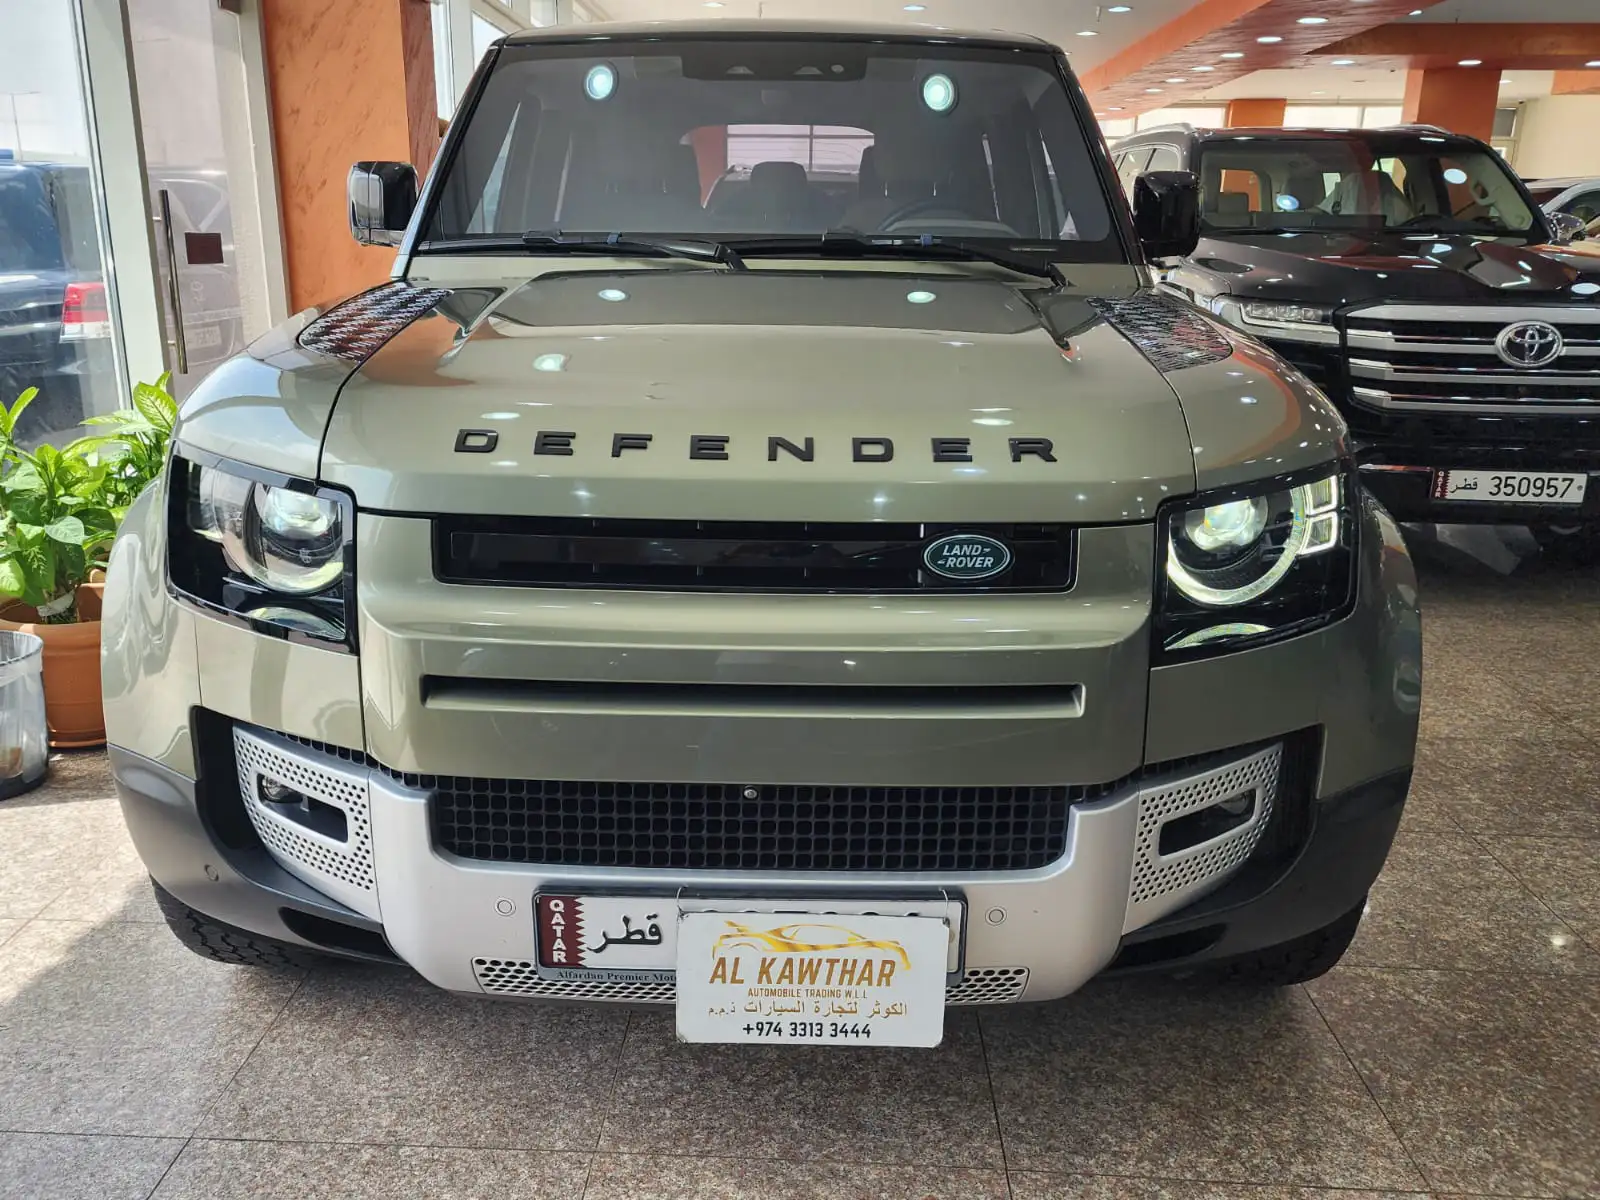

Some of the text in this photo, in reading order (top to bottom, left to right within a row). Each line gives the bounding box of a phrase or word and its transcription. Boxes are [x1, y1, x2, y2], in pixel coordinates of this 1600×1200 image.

[454, 428, 1057, 462] DEFENDER
[1434, 471, 1445, 498] QATAR
[1450, 477, 1478, 493] قطر
[1488, 476, 1575, 498] 350957
[549, 899, 568, 963] QATAR
[586, 913, 662, 954] قطر
[558, 970, 676, 981] Alfardan Premier Mot
[709, 956, 896, 987] AL KAWTHAR
[747, 987, 801, 998] AUTOMOBILE
[805, 988, 842, 999] TRADING
[743, 1000, 805, 1017] السيارات
[813, 1001, 858, 1018] لتجارة
[867, 1000, 908, 1019] الكوثر
[742, 1021, 872, 1039] +974 3313 3444
